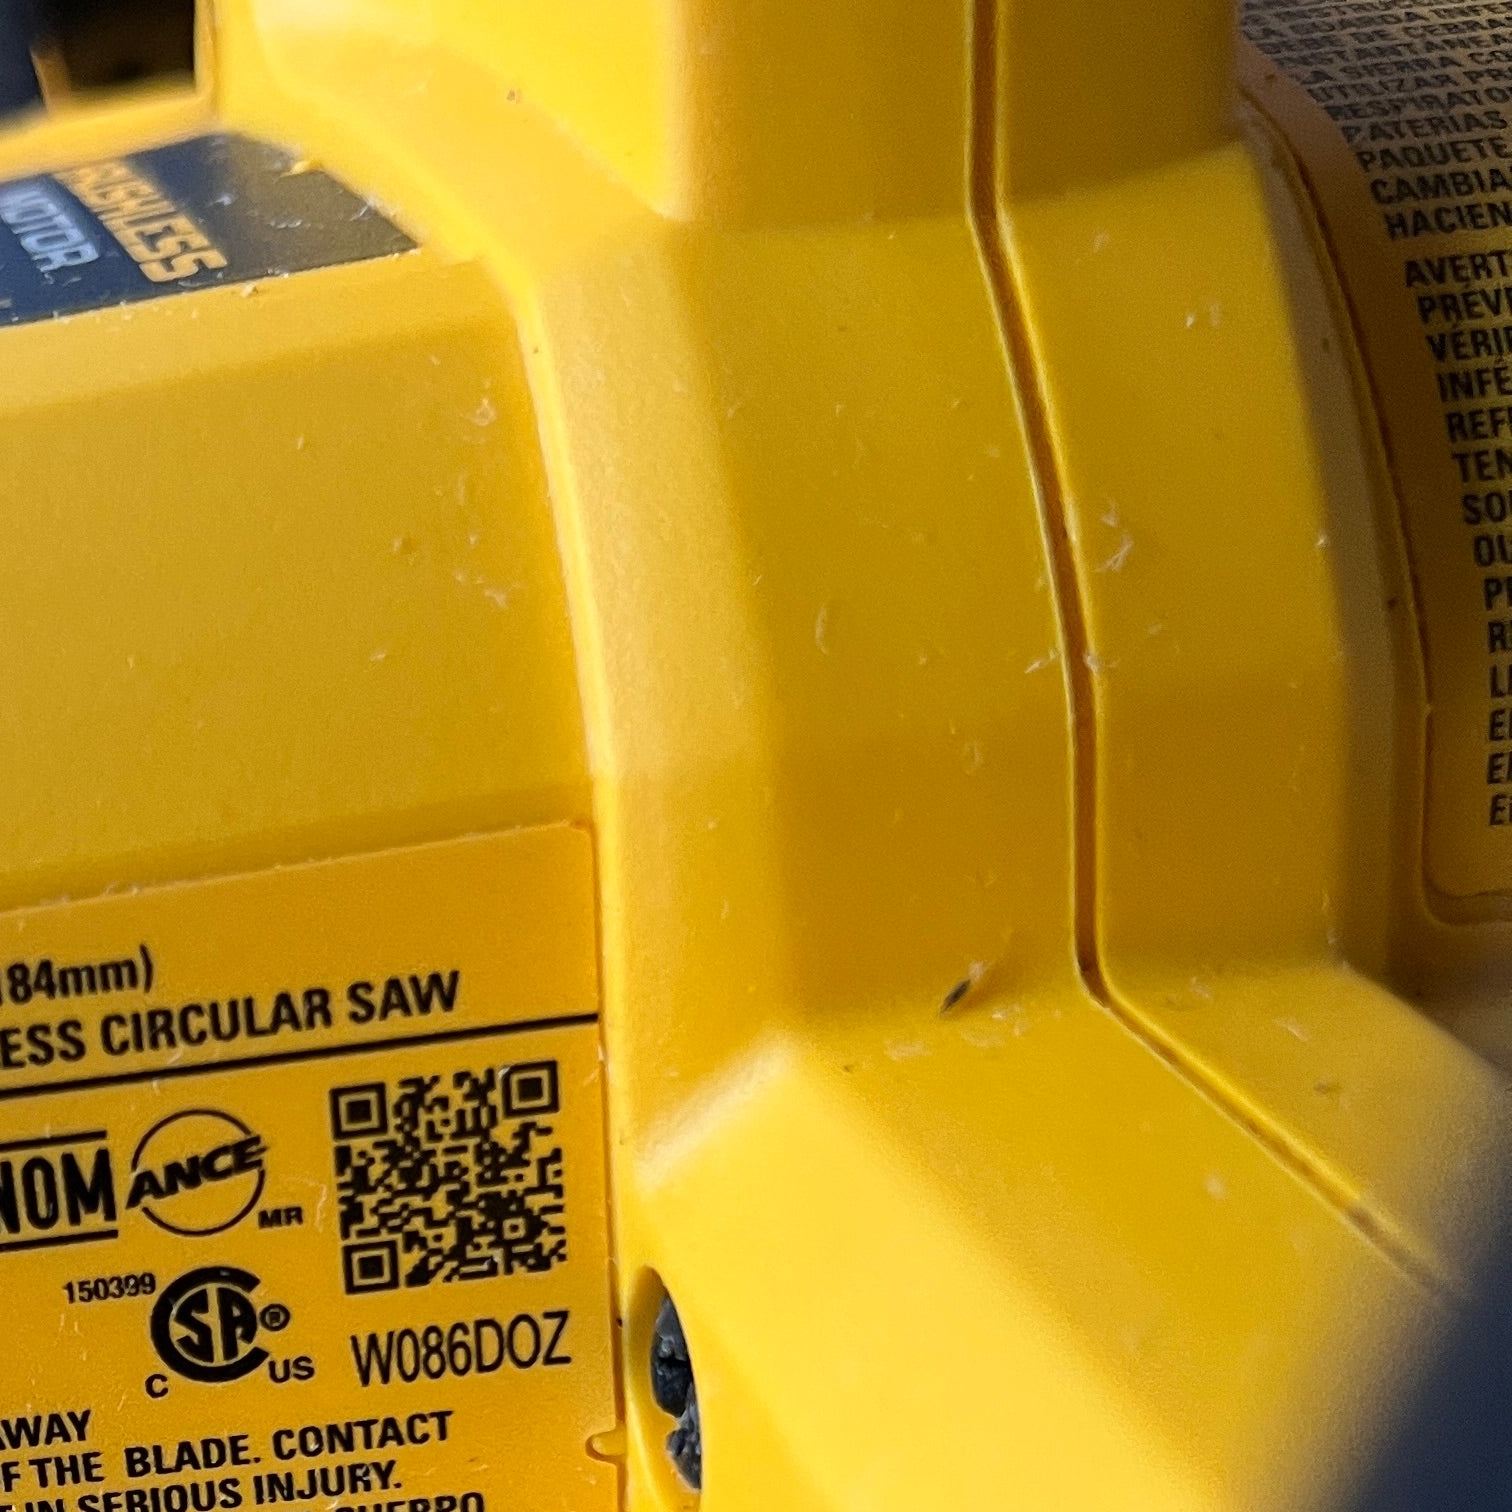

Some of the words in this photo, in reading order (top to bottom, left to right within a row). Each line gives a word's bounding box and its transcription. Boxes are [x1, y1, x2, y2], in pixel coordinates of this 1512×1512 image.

[1322, 87, 1512, 122] RESPIRATO
[1369, 167, 1512, 205] CAMBIA
[1444, 404, 1512, 444] REF
[1461, 489, 1512, 526] SO
[100, 987, 333, 1057] CIRCULAR
[346, 969, 460, 1025] SAW
[125, 1134, 270, 1210] ANCE
[257, 1205, 304, 1229] MR
[267, 1355, 316, 1384] US
[27, 1451, 105, 1489] THE
[123, 1434, 262, 1478] BLADE.
[271, 1410, 454, 1461] CONTACT
[252, 1459, 402, 1506] INJURY.
